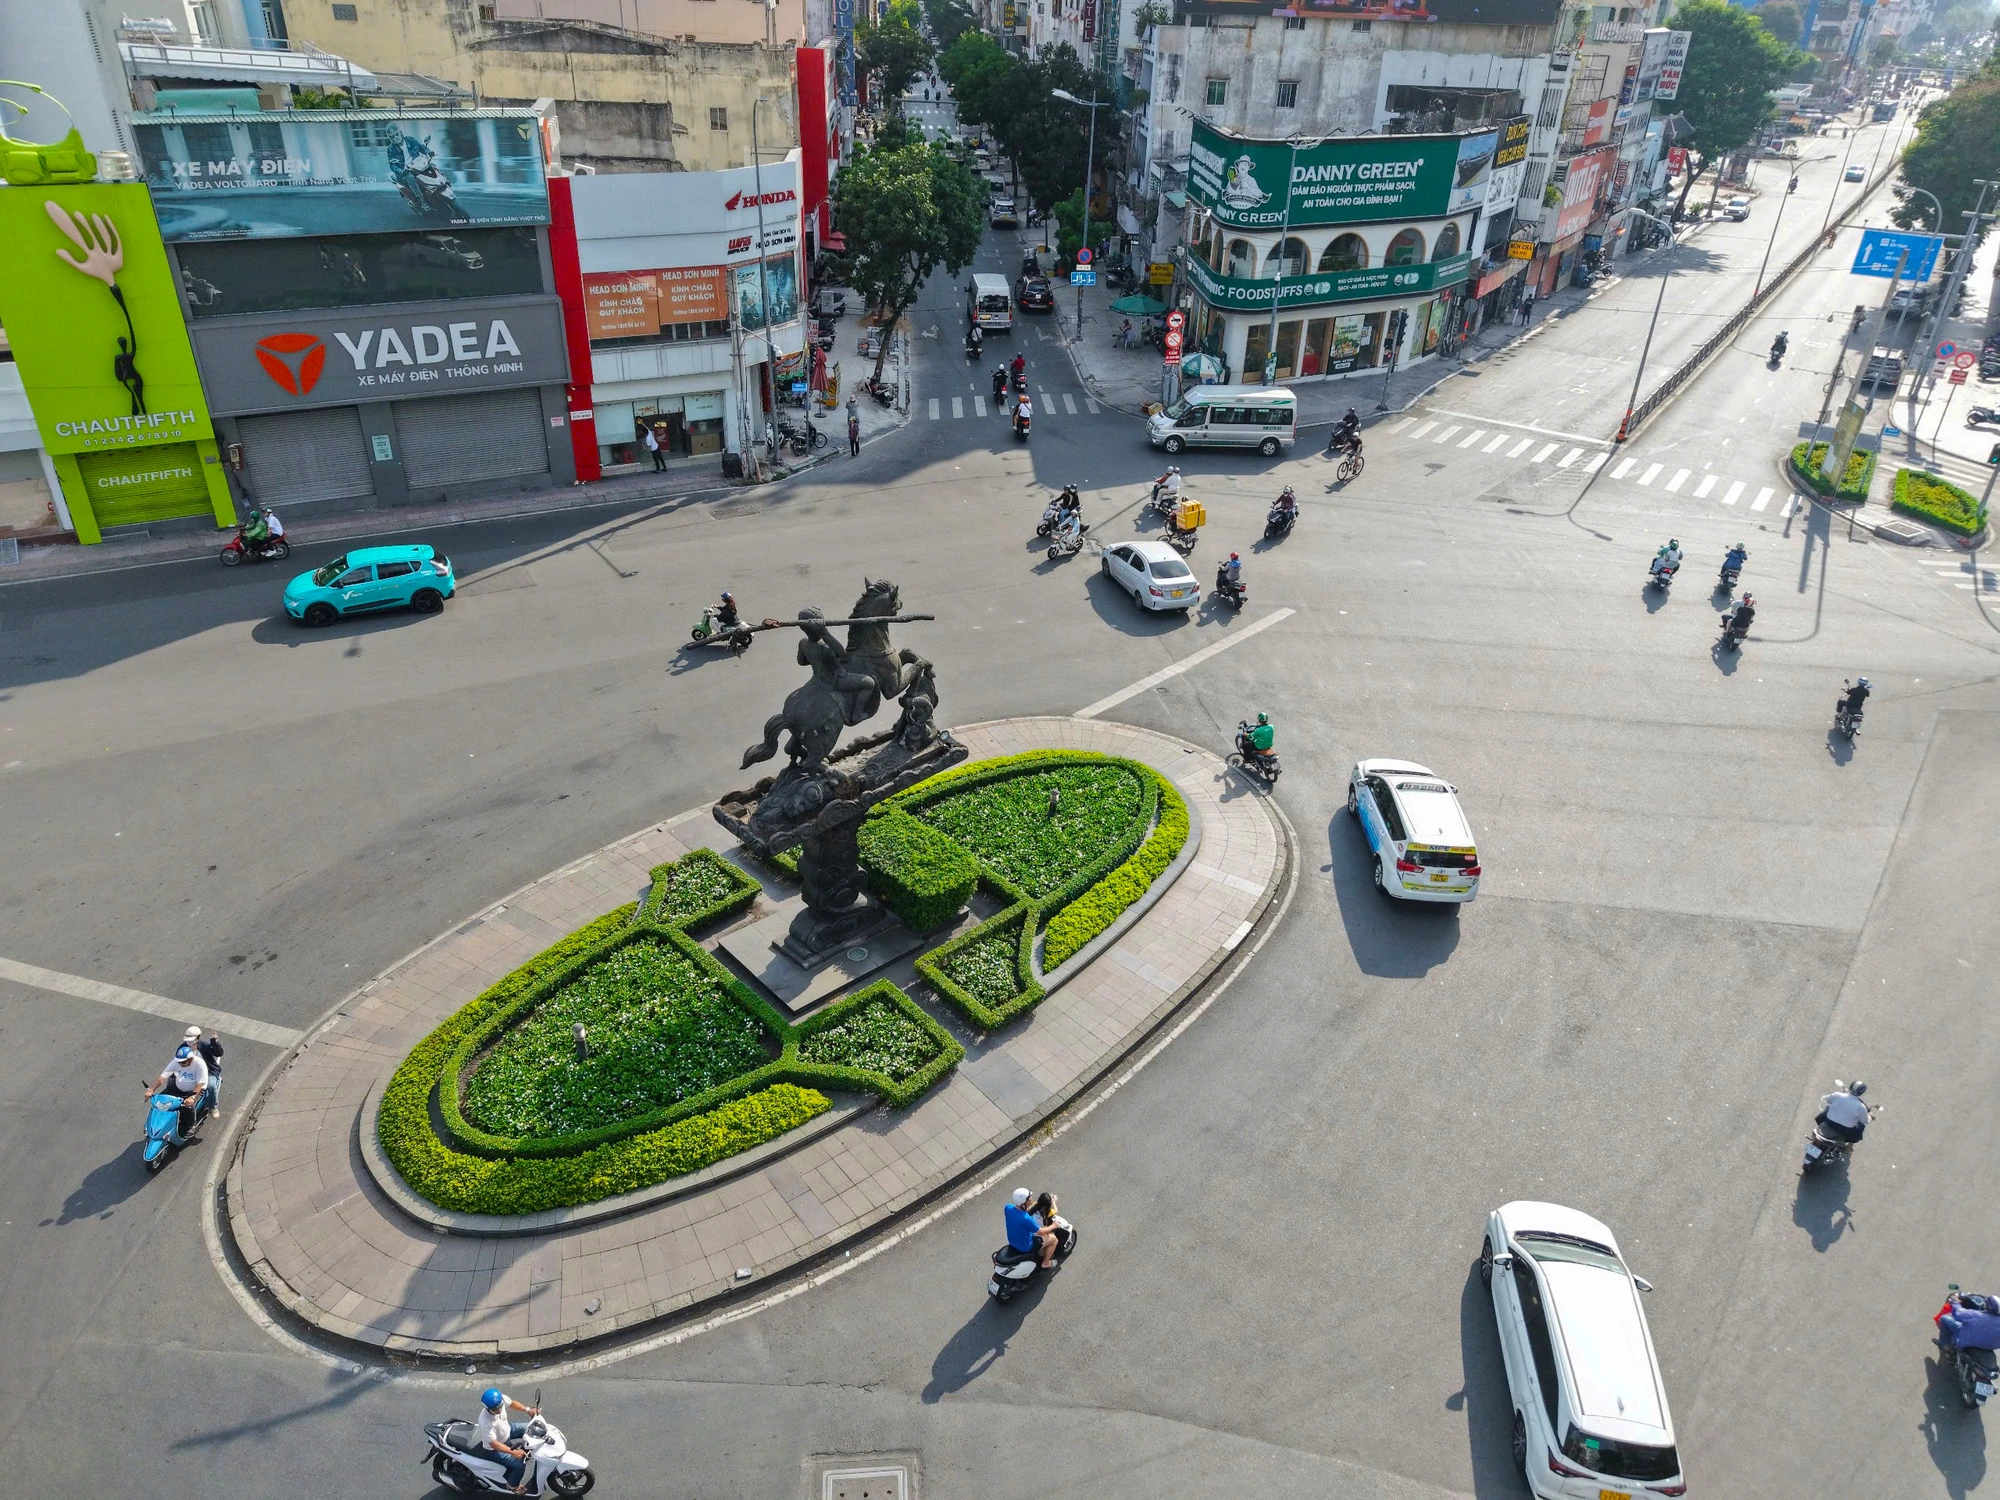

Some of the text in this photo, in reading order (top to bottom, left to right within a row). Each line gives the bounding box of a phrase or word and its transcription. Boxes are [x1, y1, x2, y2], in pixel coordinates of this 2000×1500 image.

[1669, 49, 1682, 57] NHA
[173, 157, 311, 178] XE MÁY ĐIỆN
[1292, 162, 1418, 182] DANNY GREEN
[174, 181, 213, 190] YADEA
[216, 178, 278, 190] VOLTGUARD
[1310, 184, 1326, 194] BẢO
[1564, 162, 1600, 210] OUTLET
[742, 190, 796, 208] HONDA
[1302, 200, 1314, 208] AN
[1315, 196, 1334, 207] TOÀN
[1336, 197, 1352, 206] CHO
[1352, 196, 1365, 204] GIA
[1238, 212, 1282, 222] GREEN
[662, 269, 720, 280] HEAD SƠN MINH
[590, 286, 610, 294] HEAD
[612, 284, 628, 294] SƠN
[672, 284, 713, 293] KÍNH CHÀO
[1228, 285, 1302, 300] FOODSTUFFS
[600, 296, 643, 308] KÍNH CHÀO
[672, 292, 714, 302] QUÝ KHÁCH
[600, 306, 645, 316] QUÝ KHÁCH
[333, 320, 522, 370] YADEA
[358, 362, 524, 386] XE MÁY ĐIỆN THÔNG MINH
[55, 410, 196, 437] CHAUTFIFTH
[98, 468, 192, 488] CHAUTFIFTH
